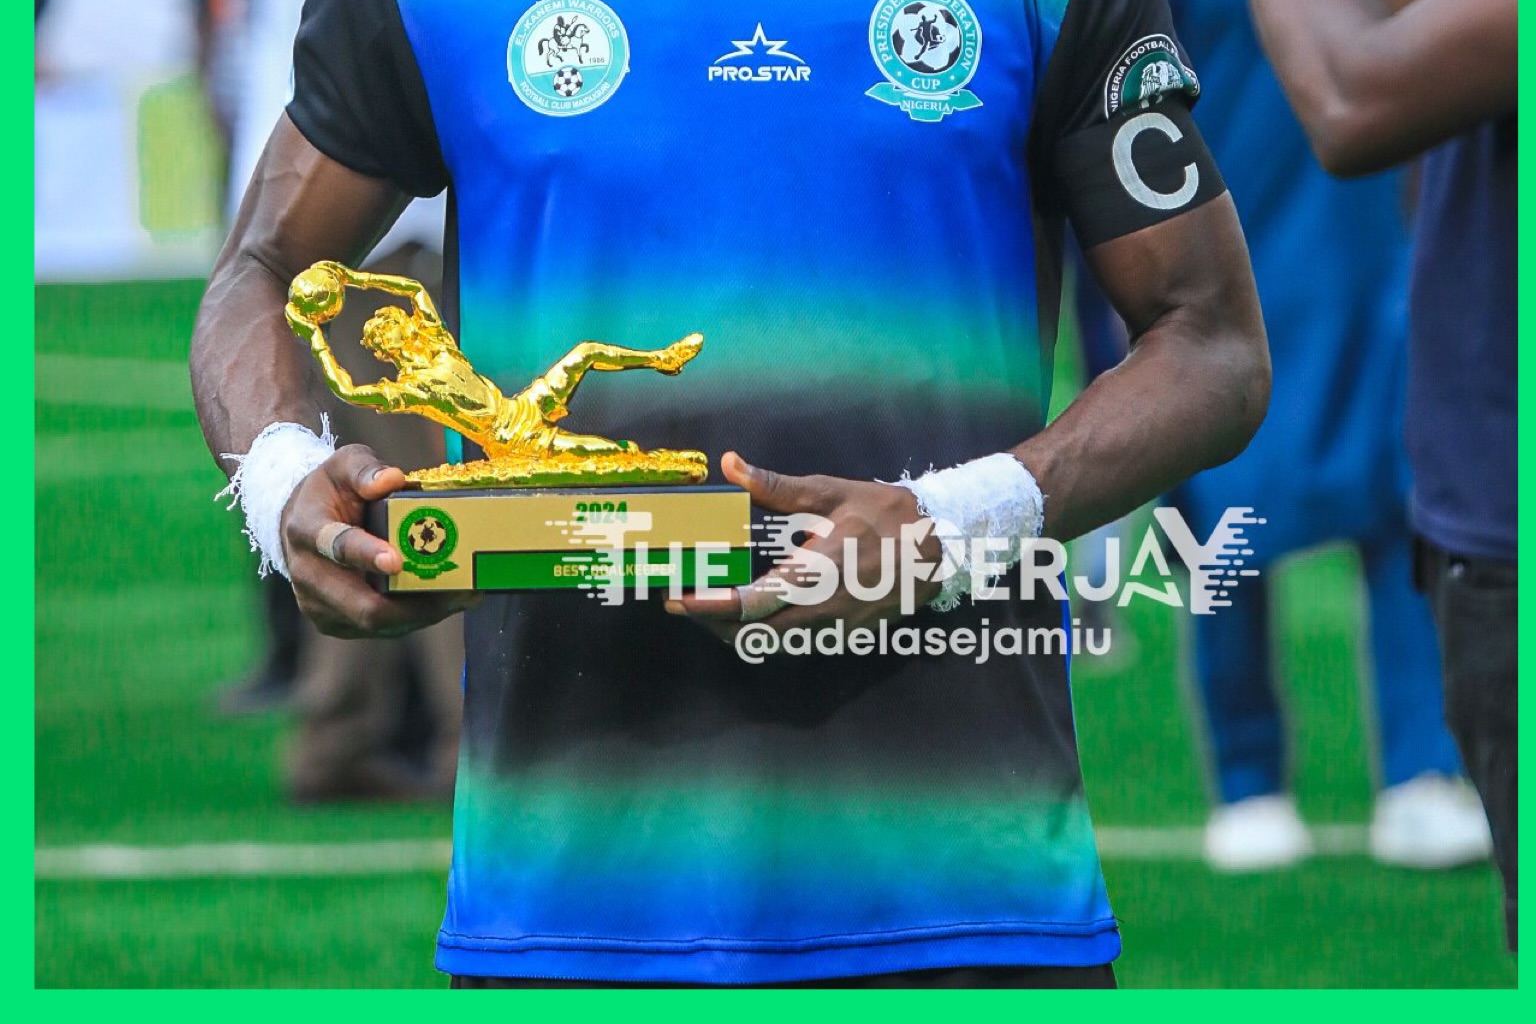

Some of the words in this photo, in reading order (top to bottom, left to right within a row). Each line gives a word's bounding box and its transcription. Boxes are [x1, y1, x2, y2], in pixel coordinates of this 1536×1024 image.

[515, 0, 566, 46] EL-KANEMI
[568, 0, 620, 39] WARRIORS
[1124, 40, 1170, 65] FOOTBALL
[520, 81, 549, 108] FOOTBALL
[551, 101, 571, 109] CLUB
[911, 77, 941, 90] CUP
[902, 99, 951, 112] NIGERIA
[1112, 112, 1199, 210] C
[575, 501, 628, 523] 2024
[553, 564, 585, 577] BEST
